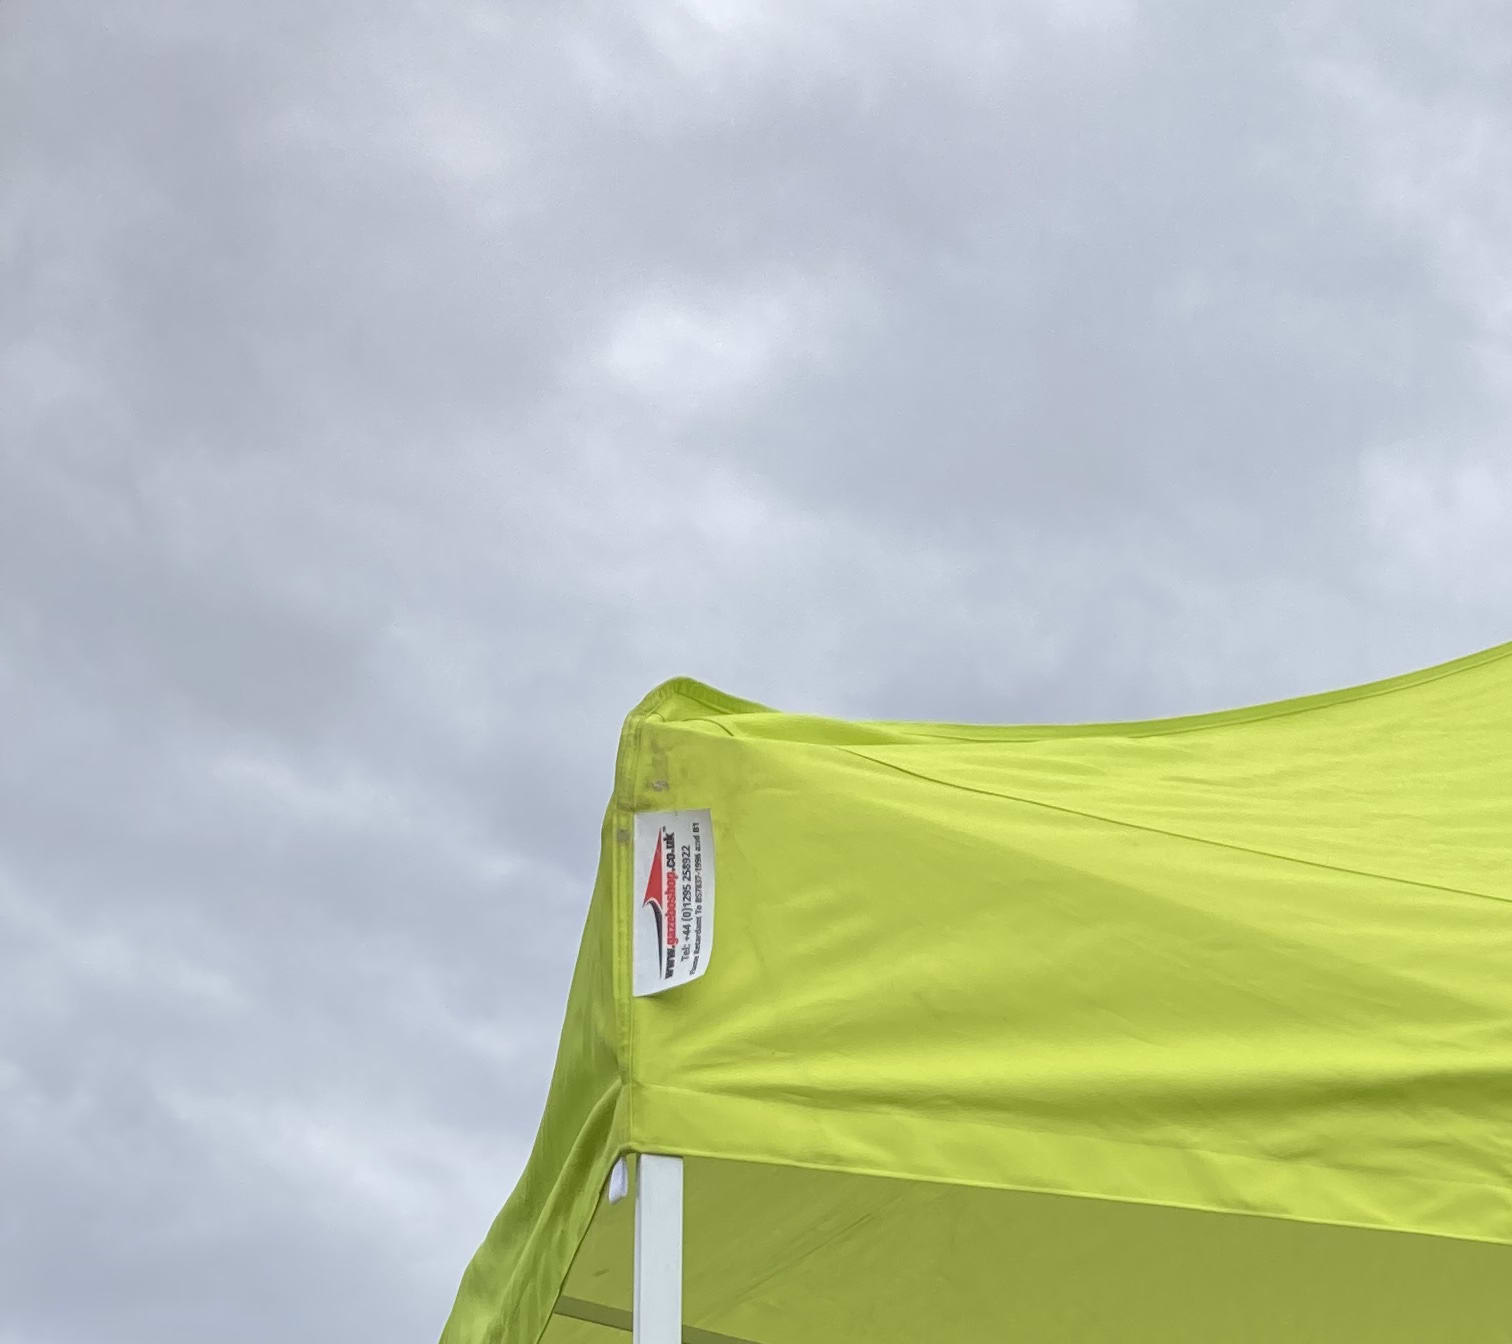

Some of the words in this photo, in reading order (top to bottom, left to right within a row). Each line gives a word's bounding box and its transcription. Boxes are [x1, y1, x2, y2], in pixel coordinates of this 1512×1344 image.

[664, 832, 679, 980] www.gazeboshop.co.uk
[694, 904, 702, 914] To
[682, 924, 691, 941] +44
[681, 942, 691, 962] Tel:
